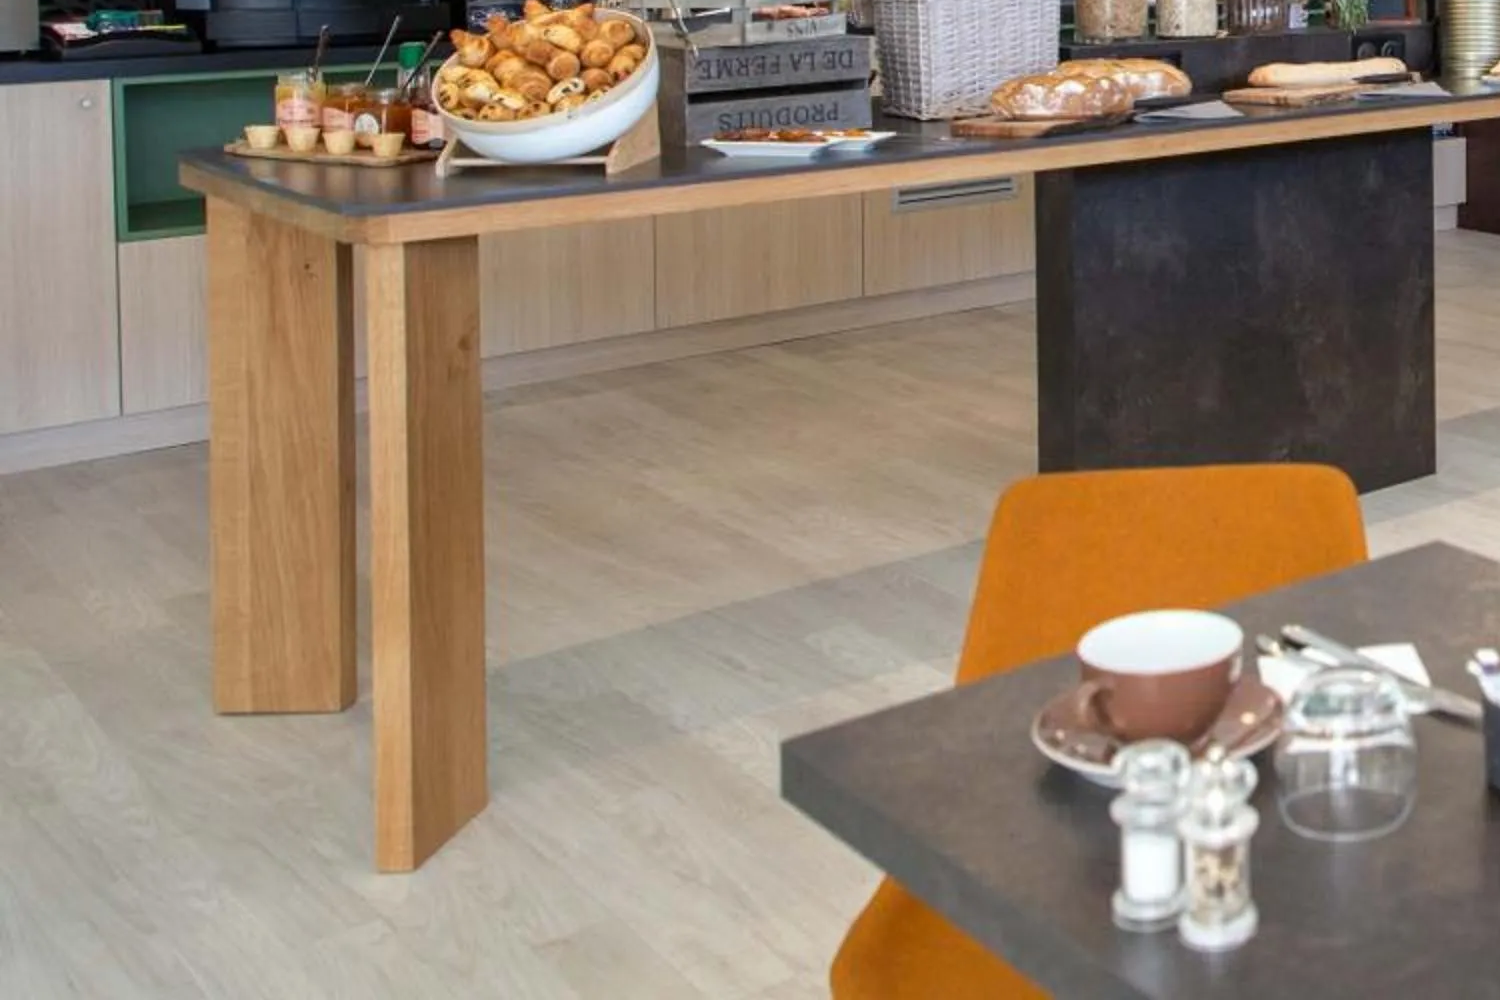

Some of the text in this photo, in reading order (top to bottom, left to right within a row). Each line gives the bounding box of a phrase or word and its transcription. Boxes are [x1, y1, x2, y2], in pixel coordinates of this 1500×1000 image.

[786, 20, 818, 38] VINS
[696, 49, 854, 81] DE LA FERME
[718, 102, 839, 132] PRODUITS
